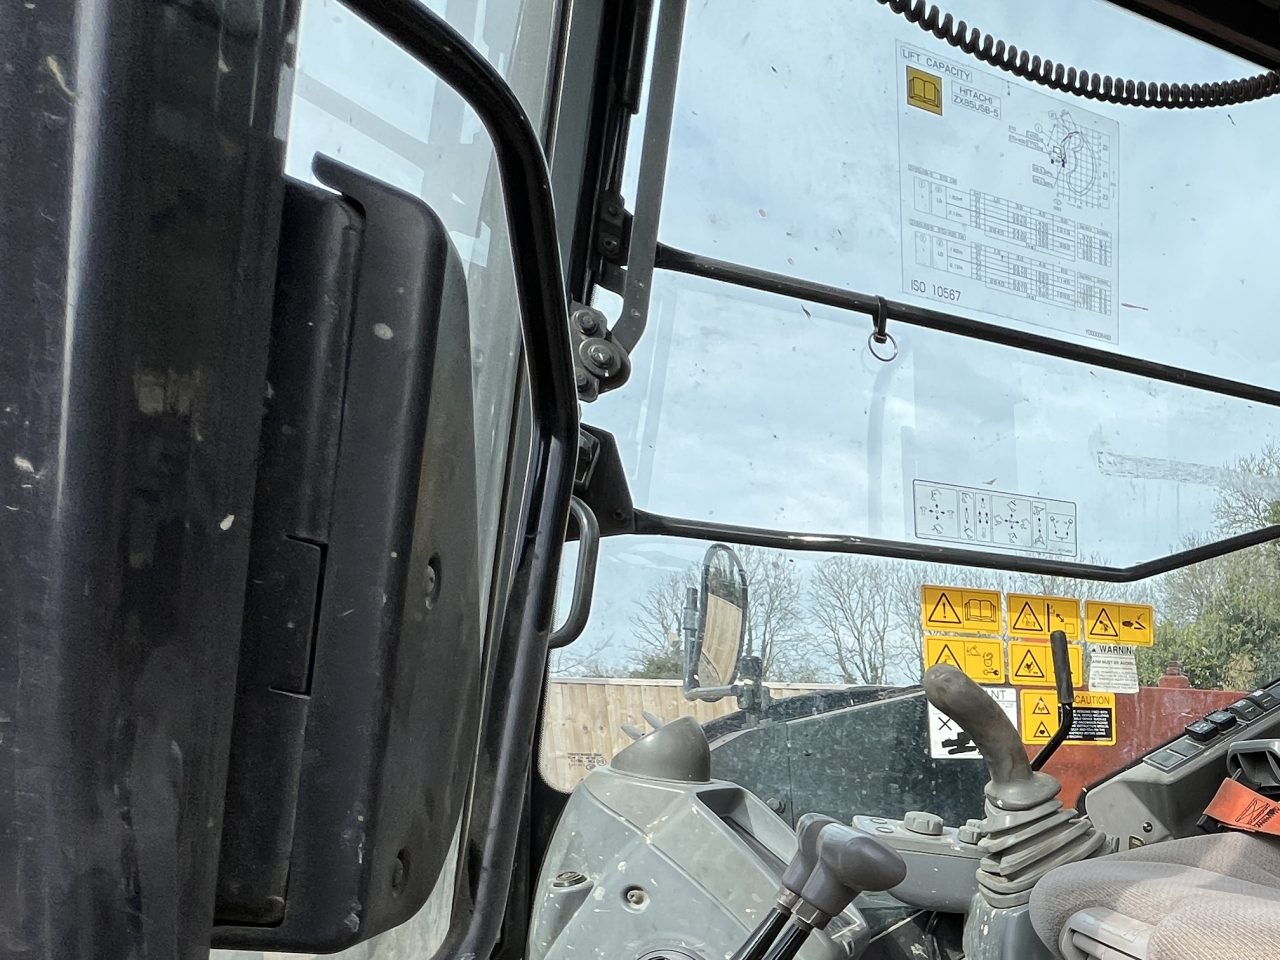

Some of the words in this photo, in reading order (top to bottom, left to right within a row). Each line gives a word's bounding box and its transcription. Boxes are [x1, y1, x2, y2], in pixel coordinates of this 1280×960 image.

[902, 49, 921, 64] LIFT
[926, 56, 971, 81] CAPACITY
[959, 85, 994, 105] HITACHI
[910, 279, 927, 294] ISO
[932, 285, 962, 302] 10567
[1075, 694, 1110, 705] CAUTION
